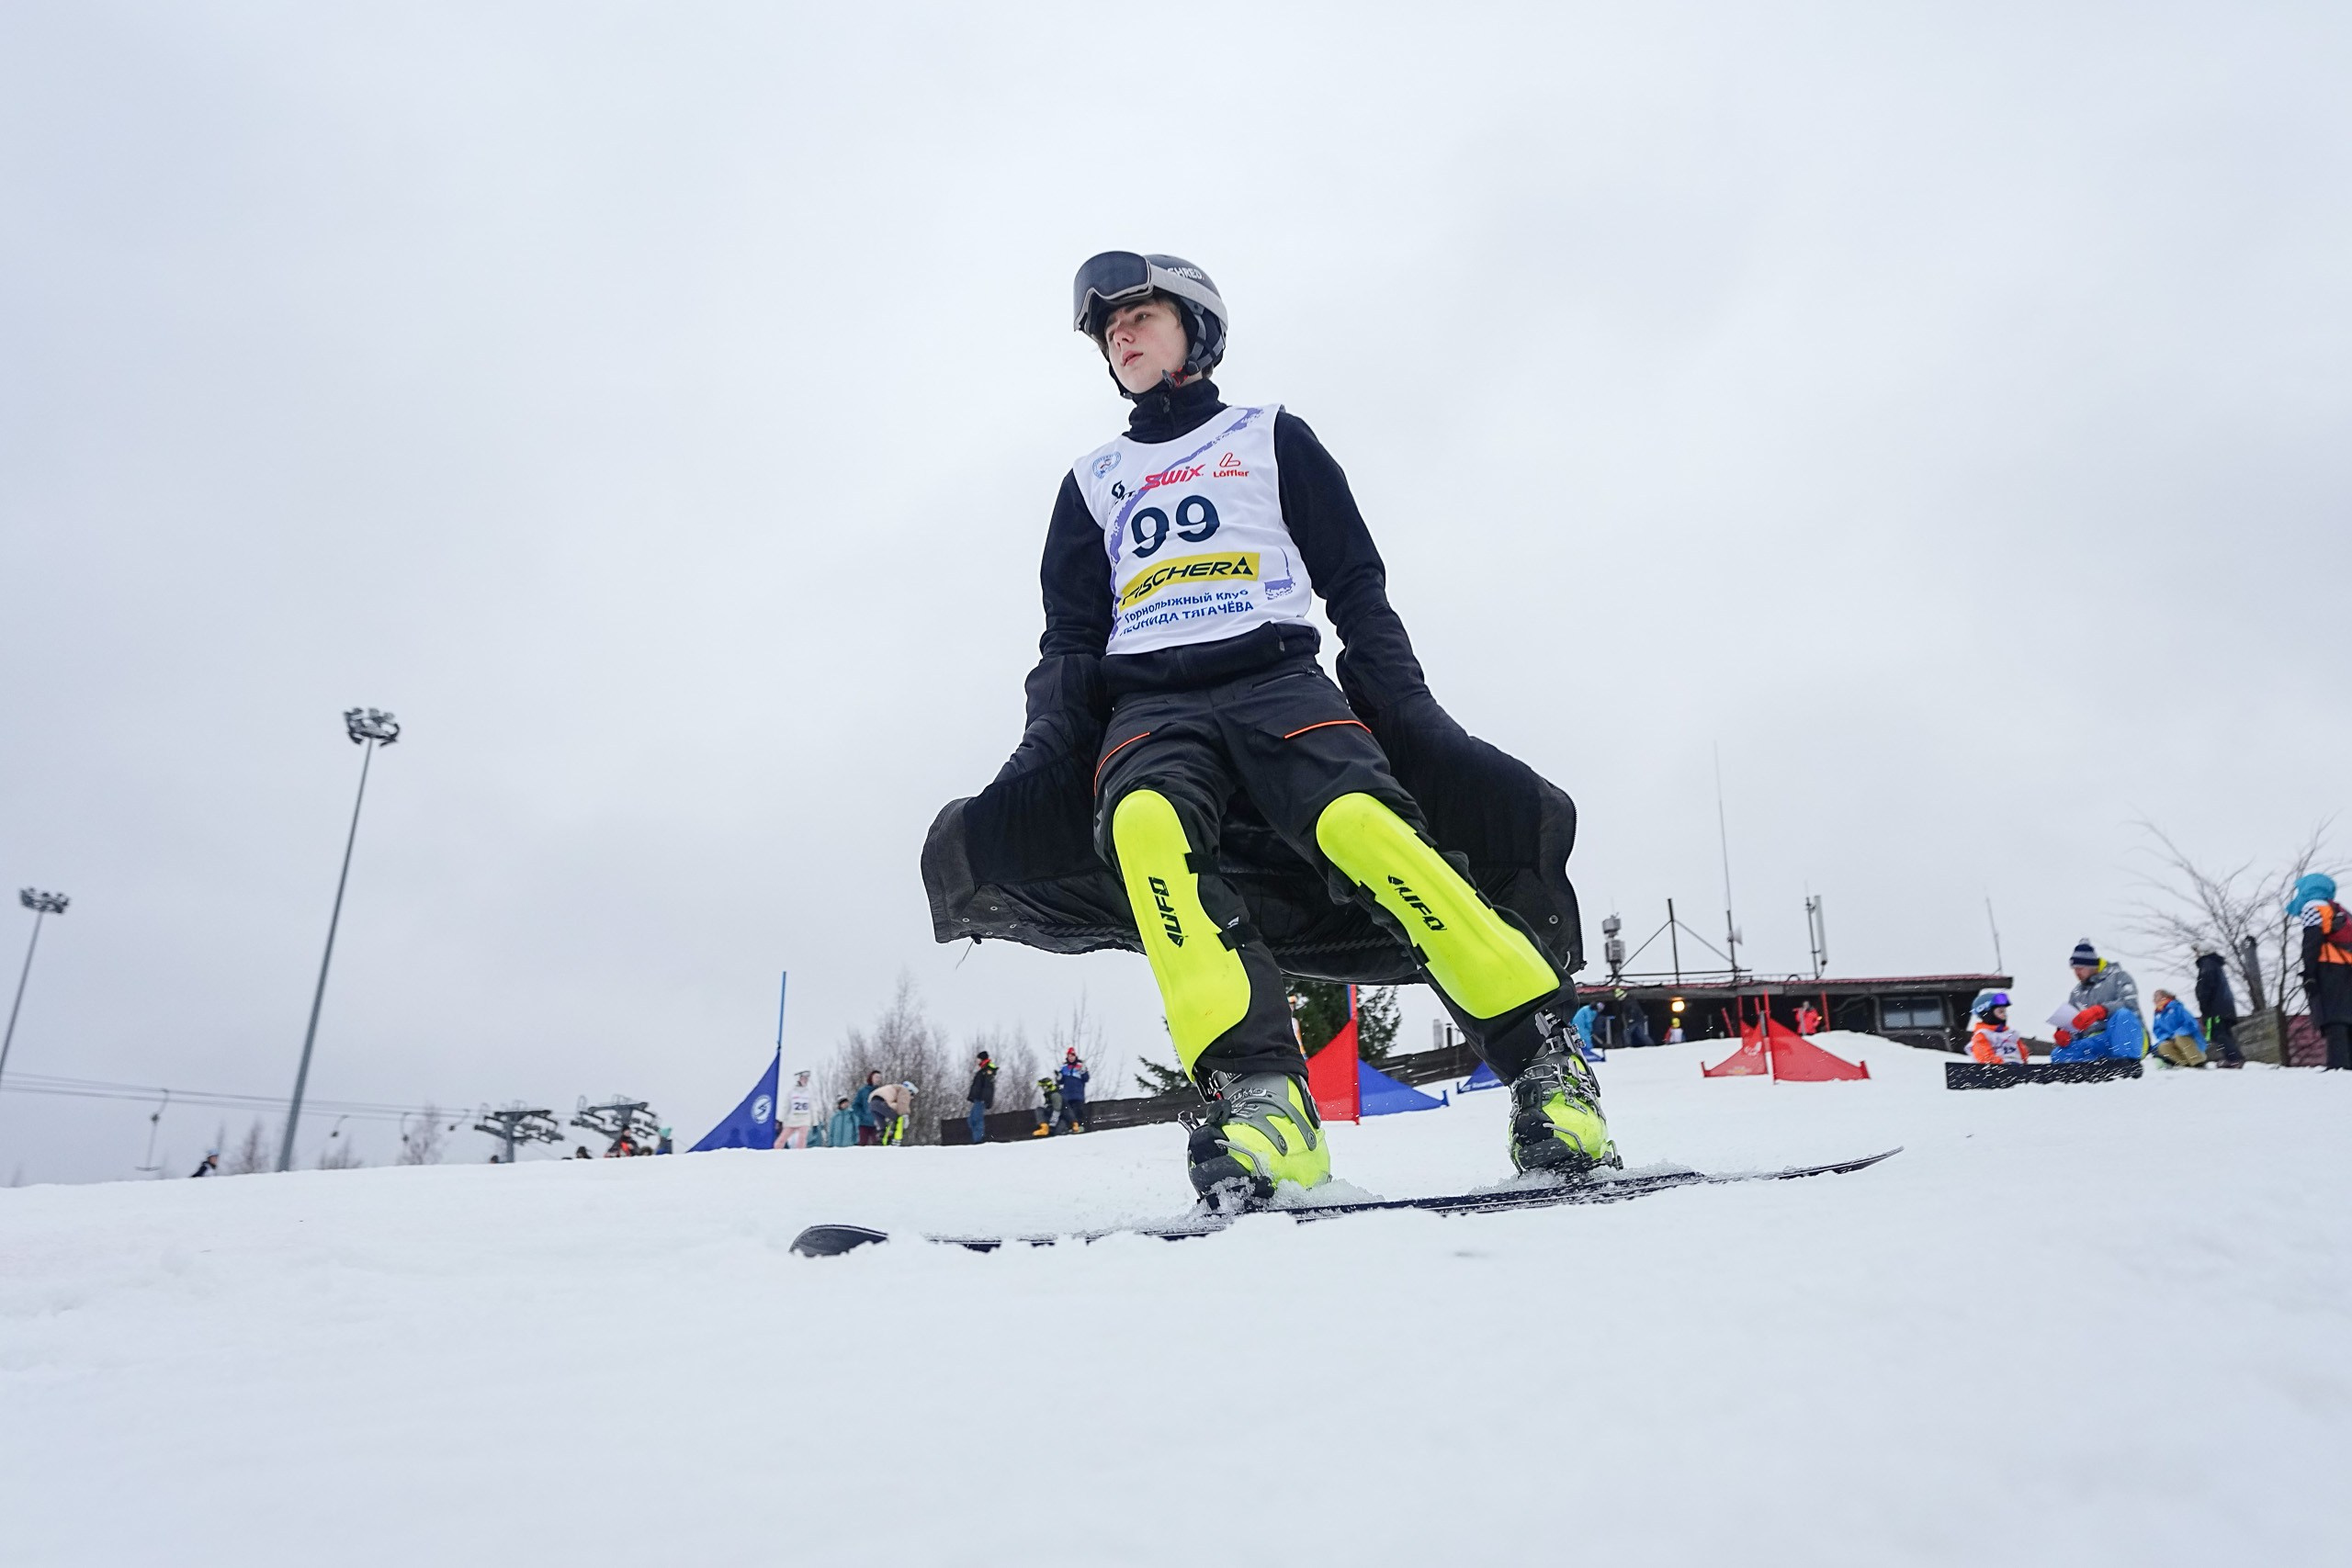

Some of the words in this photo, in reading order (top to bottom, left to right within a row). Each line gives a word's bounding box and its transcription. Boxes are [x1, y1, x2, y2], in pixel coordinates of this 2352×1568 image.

[1213, 469, 1250, 479] Löffler
[1131, 494, 1220, 558] 99
[1122, 561, 1233, 606] FISCHER
[1125, 592, 1213, 624] Горнолыжный
[1182, 601, 1254, 619] ТЯГАЧЁВА
[1148, 876, 1182, 934] UFO
[1395, 886, 1448, 931] UFO
